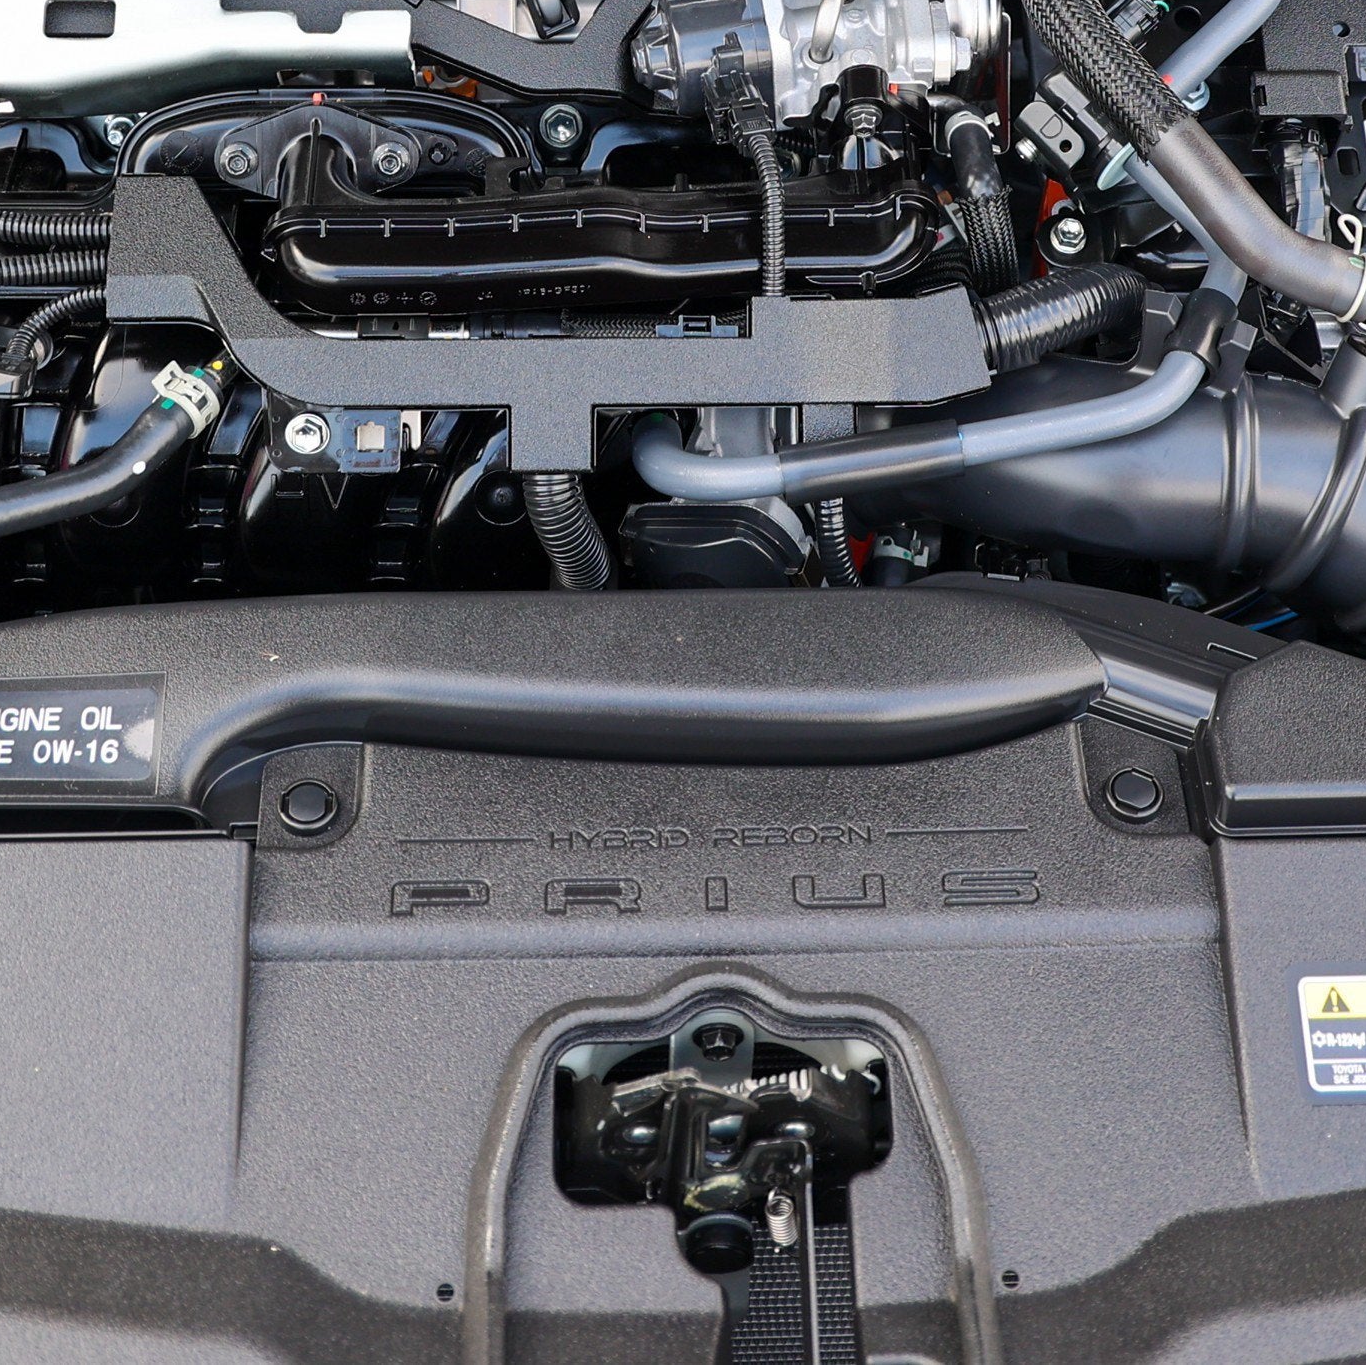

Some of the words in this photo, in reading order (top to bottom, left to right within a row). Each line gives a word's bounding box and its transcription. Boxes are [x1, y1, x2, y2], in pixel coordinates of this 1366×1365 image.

[80, 706, 123, 731] OIL
[33, 739, 120, 764] 0W-16
[548, 830, 692, 850] HYBRID
[712, 825, 873, 847] REBORN
[388, 868, 1042, 918] PRIUS
[1331, 1064, 1364, 1074] TOYOTA
[1333, 1074, 1350, 1084] SAE
